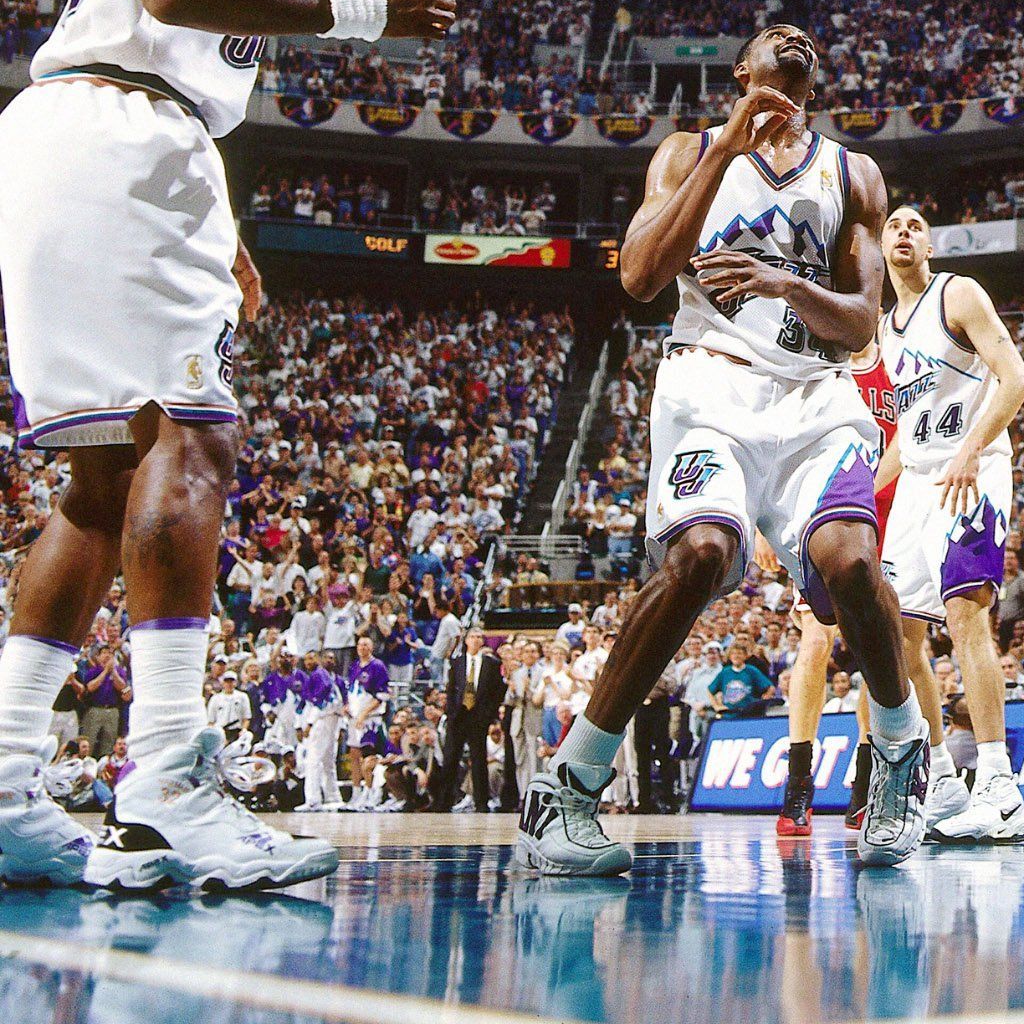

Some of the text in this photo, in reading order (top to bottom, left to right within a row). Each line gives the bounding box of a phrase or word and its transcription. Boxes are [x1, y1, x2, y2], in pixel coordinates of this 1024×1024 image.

[364, 235, 408, 253] GOLF
[912, 402, 963, 444] 44
[702, 738, 763, 789] WE
